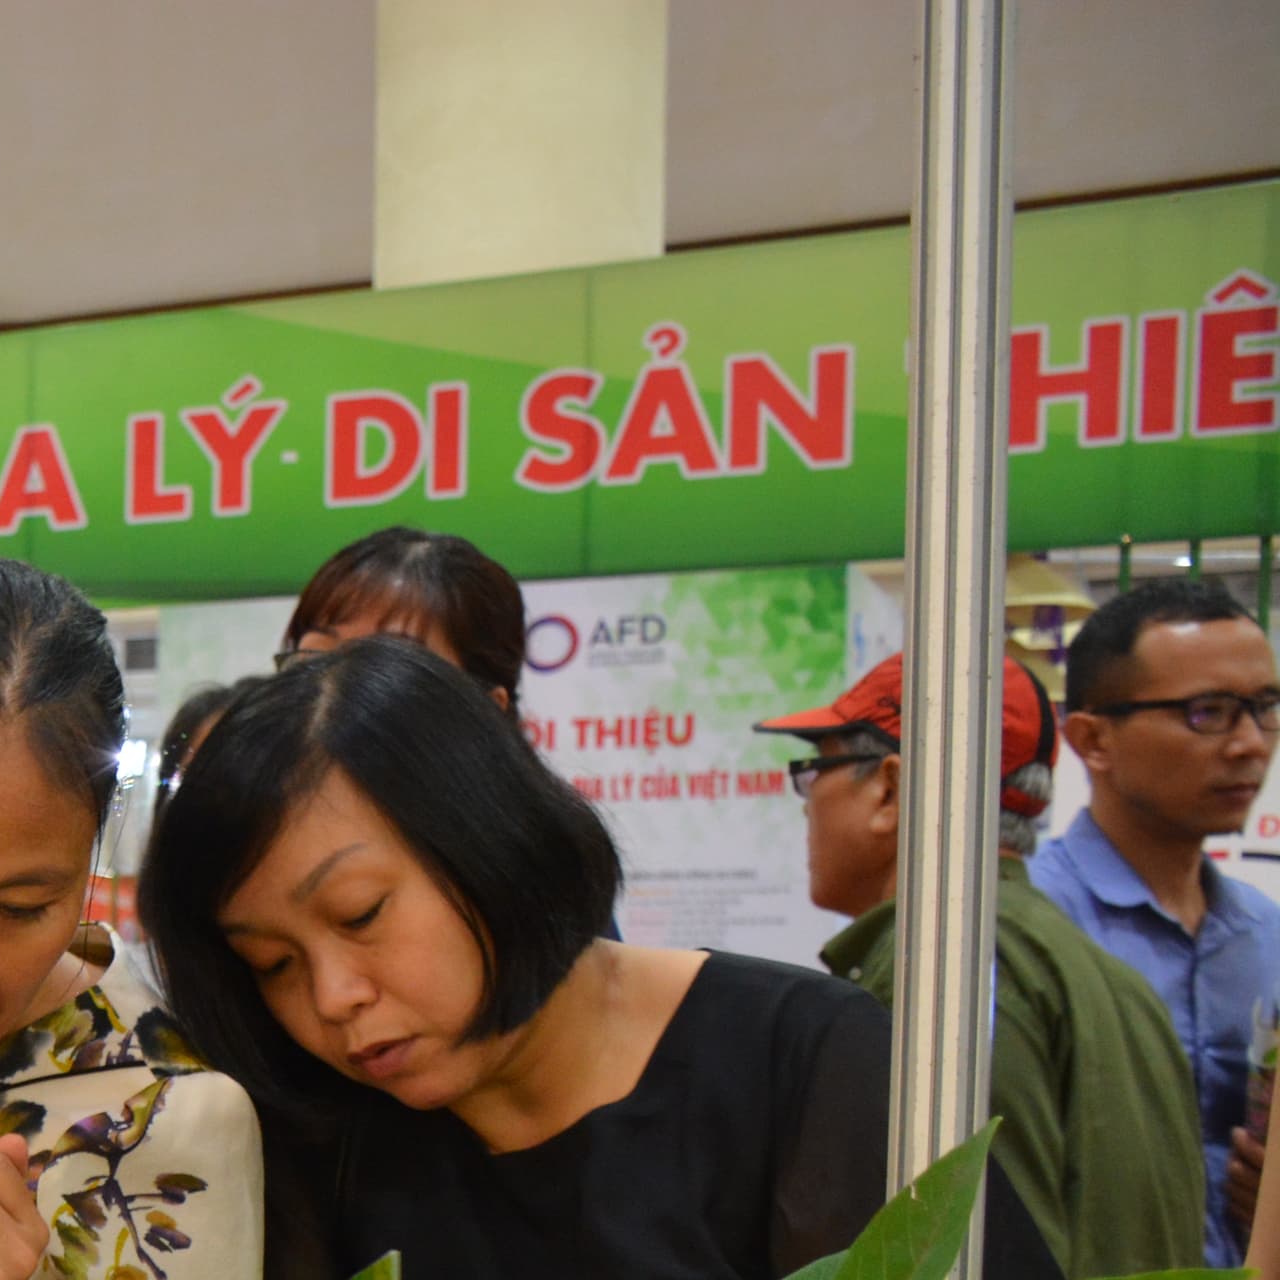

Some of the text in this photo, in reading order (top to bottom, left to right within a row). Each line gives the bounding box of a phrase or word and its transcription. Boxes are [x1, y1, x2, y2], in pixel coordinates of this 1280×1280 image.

[126, 375, 287, 523] LÝ
[326, 381, 468, 507] DI
[515, 322, 854, 493] SẢN
[1007, 267, 1280, 453] HIÊ
[589, 613, 667, 646] AFD
[571, 706, 694, 755] THIỆU
[688, 767, 729, 805] VIỆT
[737, 769, 785, 798] NAM
